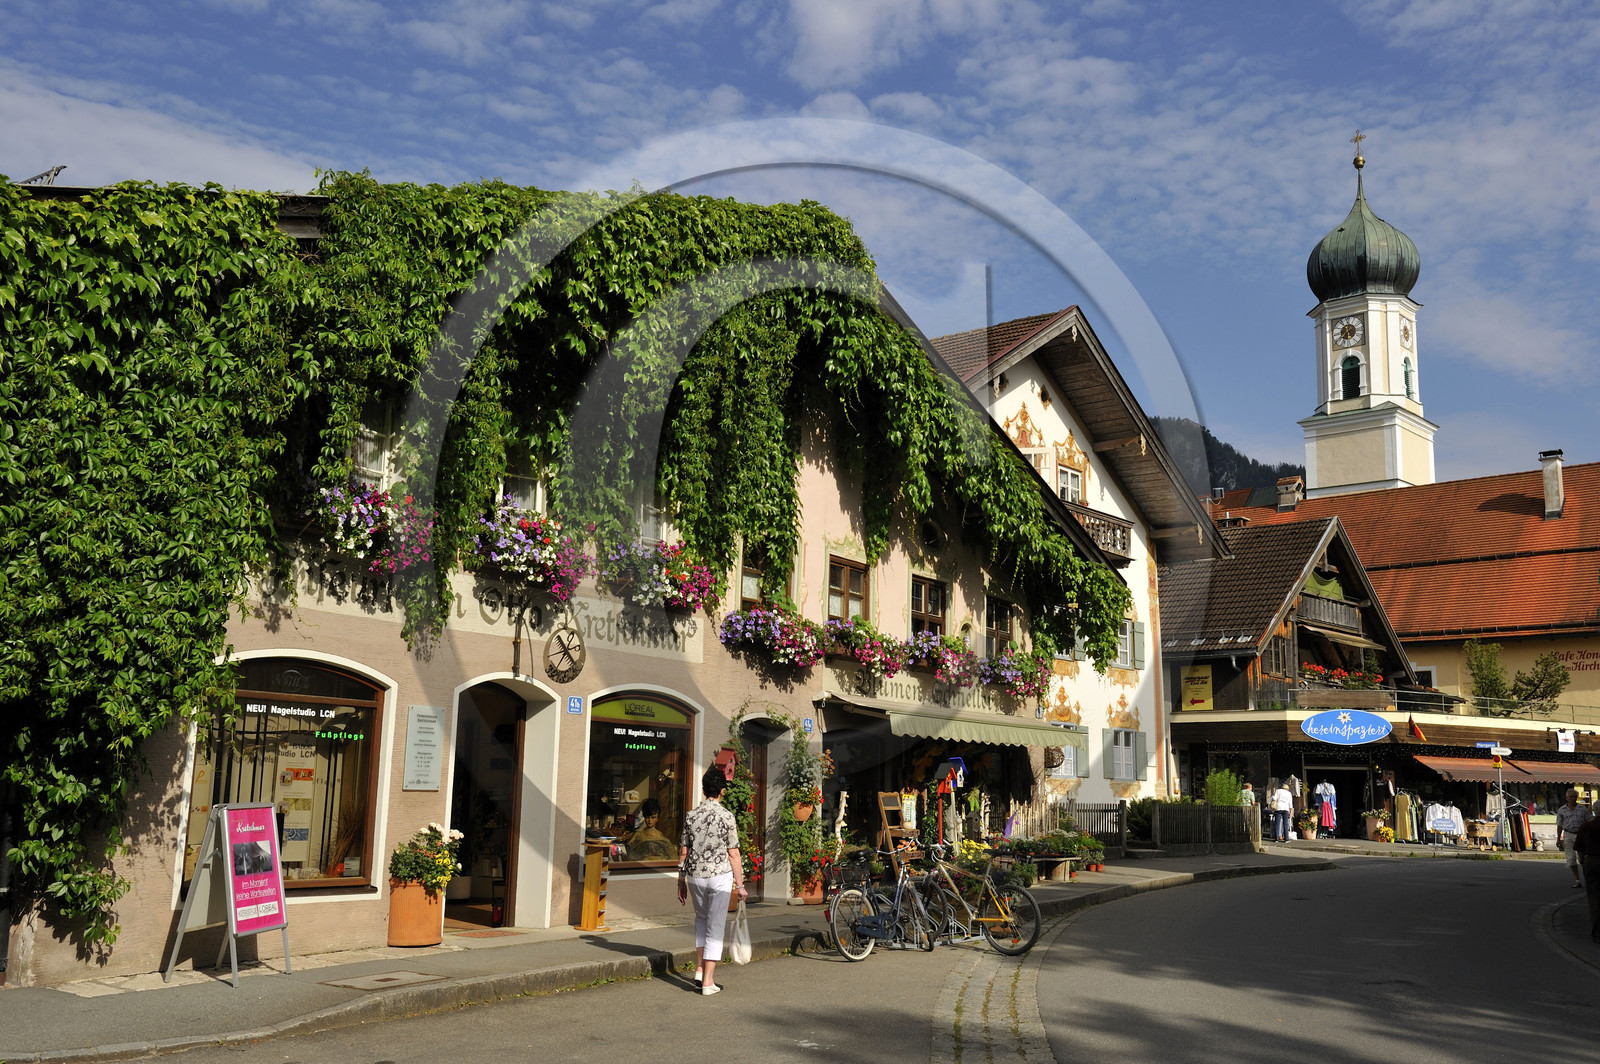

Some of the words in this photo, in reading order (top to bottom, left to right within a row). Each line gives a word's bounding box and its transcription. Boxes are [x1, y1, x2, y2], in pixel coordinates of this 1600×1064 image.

[246, 703, 267, 713] NEU!
[270, 705, 316, 717] Nagelstudio
[319, 709, 336, 719] LCN
[315, 730, 364, 741] Fußpflege
[613, 727, 626, 736] NEU!
[627, 728, 655, 738] Nagelstudio
[1307, 717, 1386, 741] hereinspaziert
